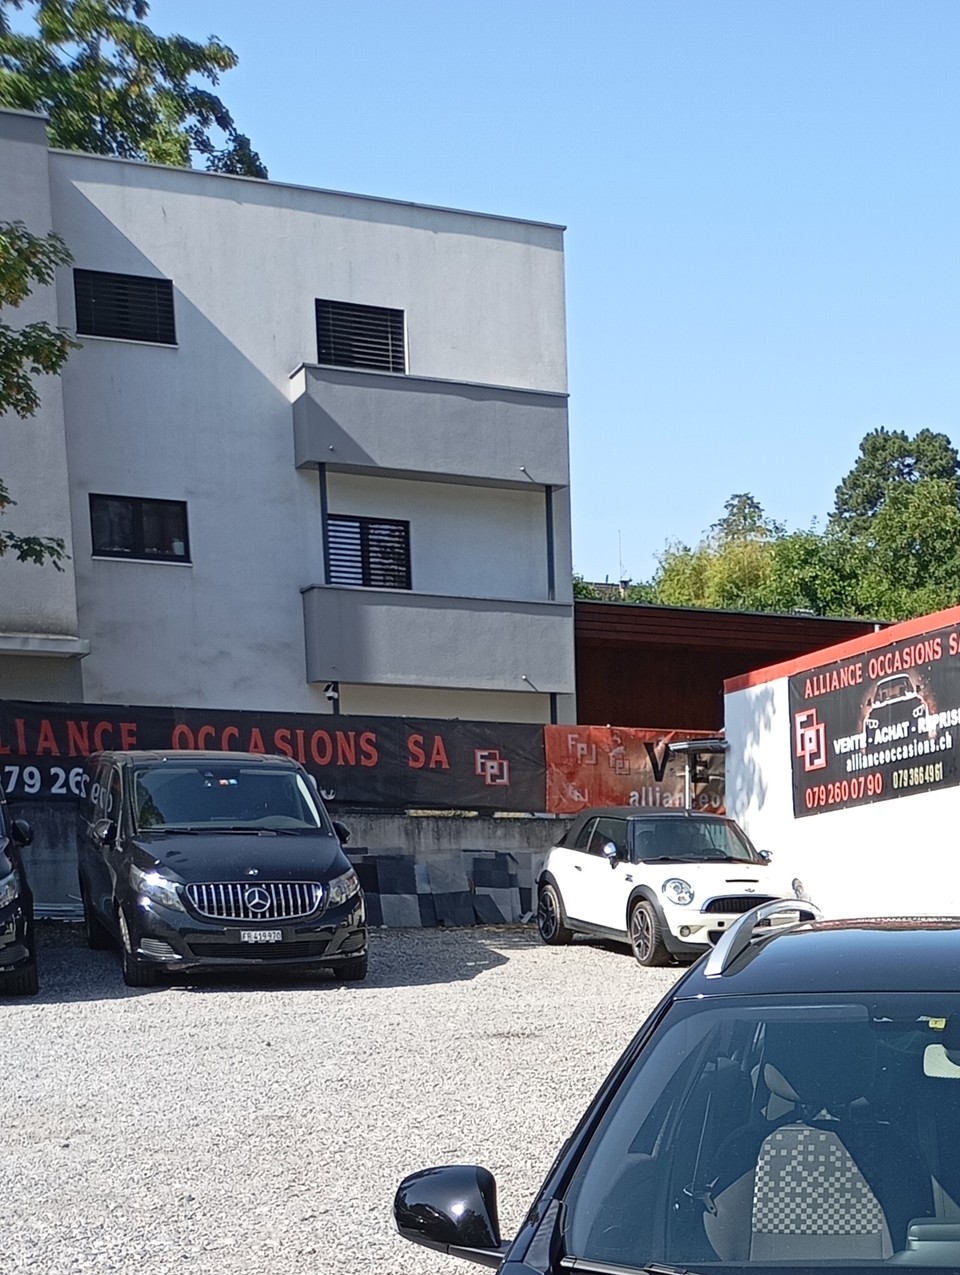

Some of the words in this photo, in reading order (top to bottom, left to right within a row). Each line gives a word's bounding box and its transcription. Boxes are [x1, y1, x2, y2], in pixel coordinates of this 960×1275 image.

[804, 662, 863, 699] ALLIANCE
[868, 637, 942, 679] OCCASIONS
[171, 724, 380, 767] OCCASIONS
[407, 733, 450, 769] SA
[846, 731, 953, 772] allianceoccasions.ch
[874, 721, 910, 745] ACHAT
